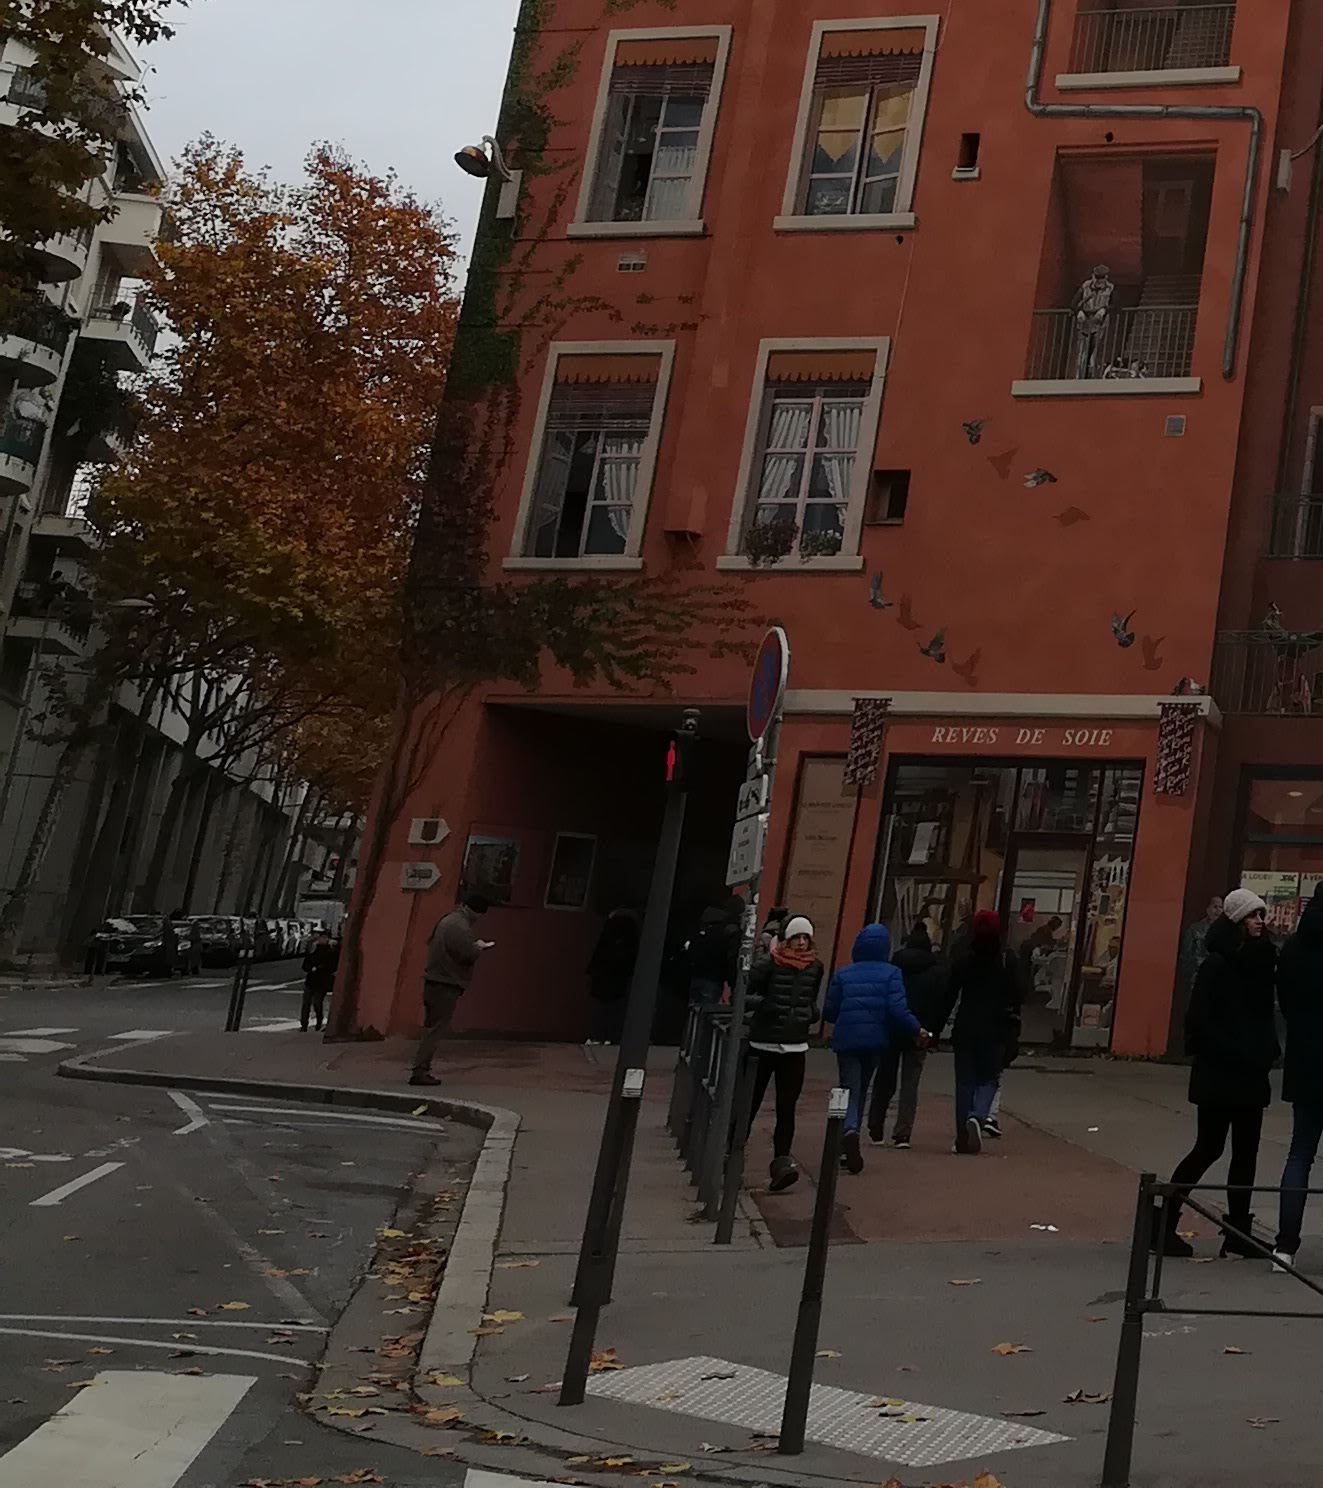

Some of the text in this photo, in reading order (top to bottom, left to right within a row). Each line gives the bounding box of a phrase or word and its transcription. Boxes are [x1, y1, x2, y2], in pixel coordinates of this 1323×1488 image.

[931, 726, 1113, 746] REVES DE SOIE
